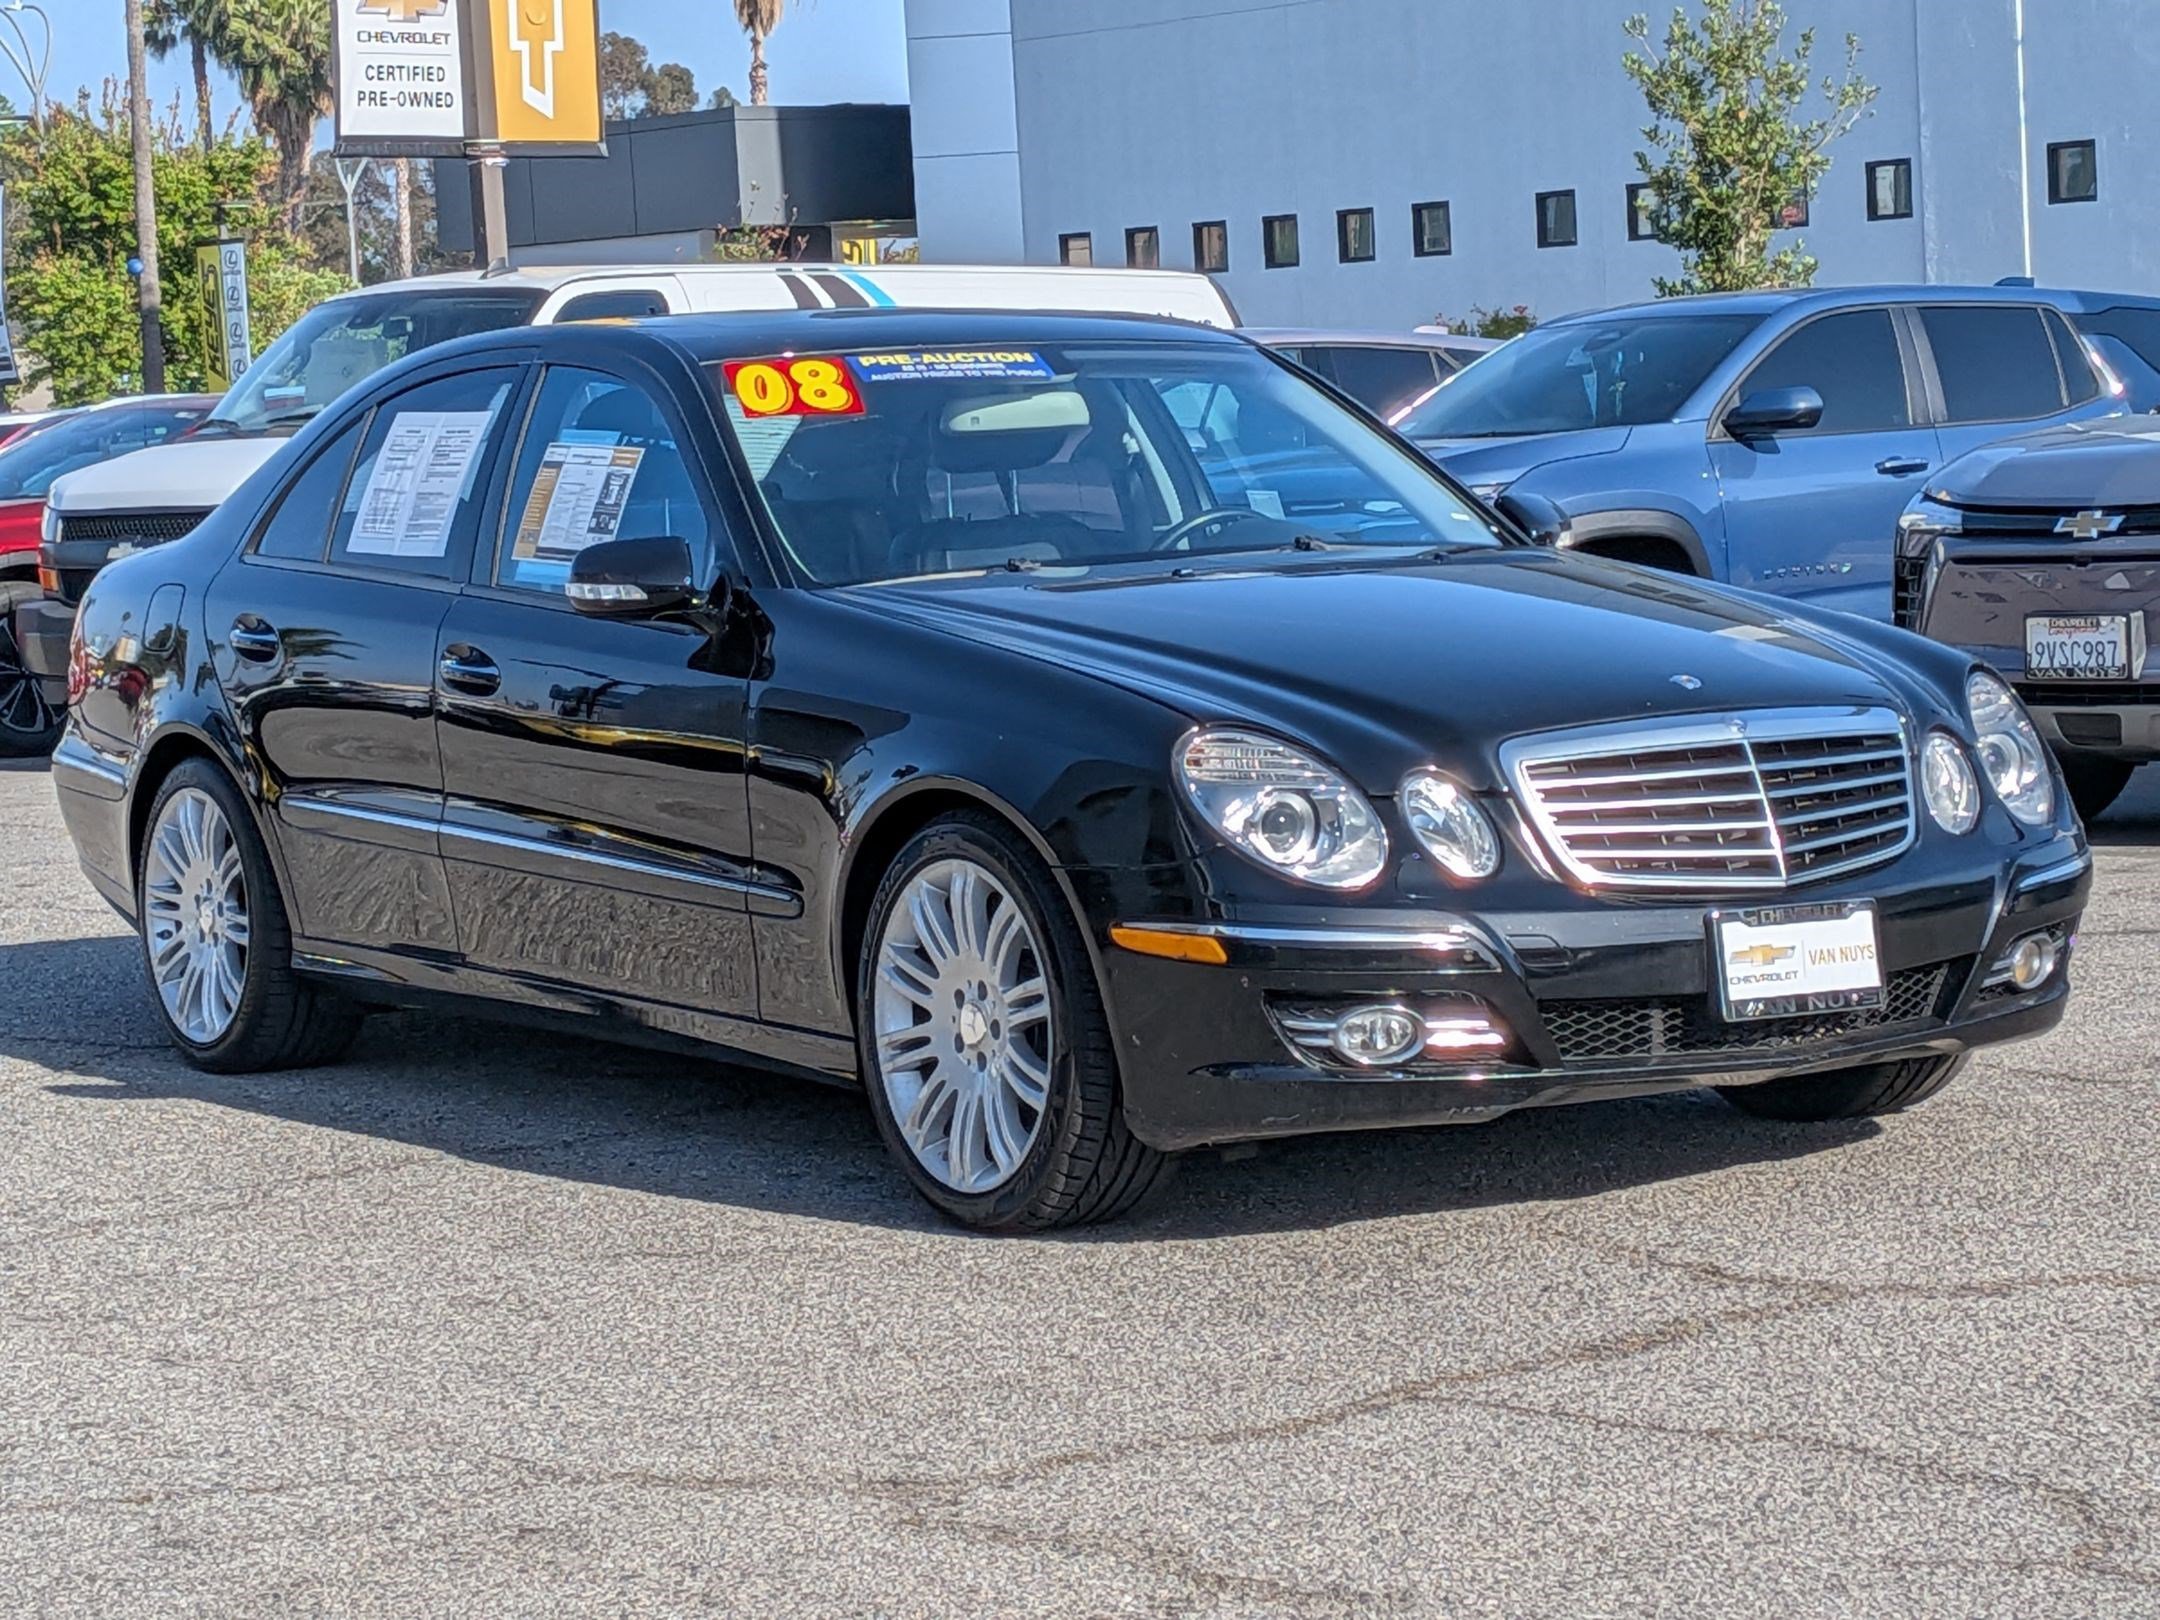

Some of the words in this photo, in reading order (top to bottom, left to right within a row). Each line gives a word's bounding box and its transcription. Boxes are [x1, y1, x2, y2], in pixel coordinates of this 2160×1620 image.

[356, 30, 451, 45] CHEVROLET
[365, 64, 446, 83] CERTIFIED
[357, 91, 454, 109] PRE-OWNED
[858, 352, 1035, 367] PRE-AUCTION
[735, 359, 853, 415] 08
[2034, 667, 2068, 678] VAN
[2075, 666, 2119, 678] NUYS
[1808, 949, 1837, 967] VAN
[1840, 944, 1876, 964] NUYS
[1729, 970, 1799, 986] CHEVROLET
